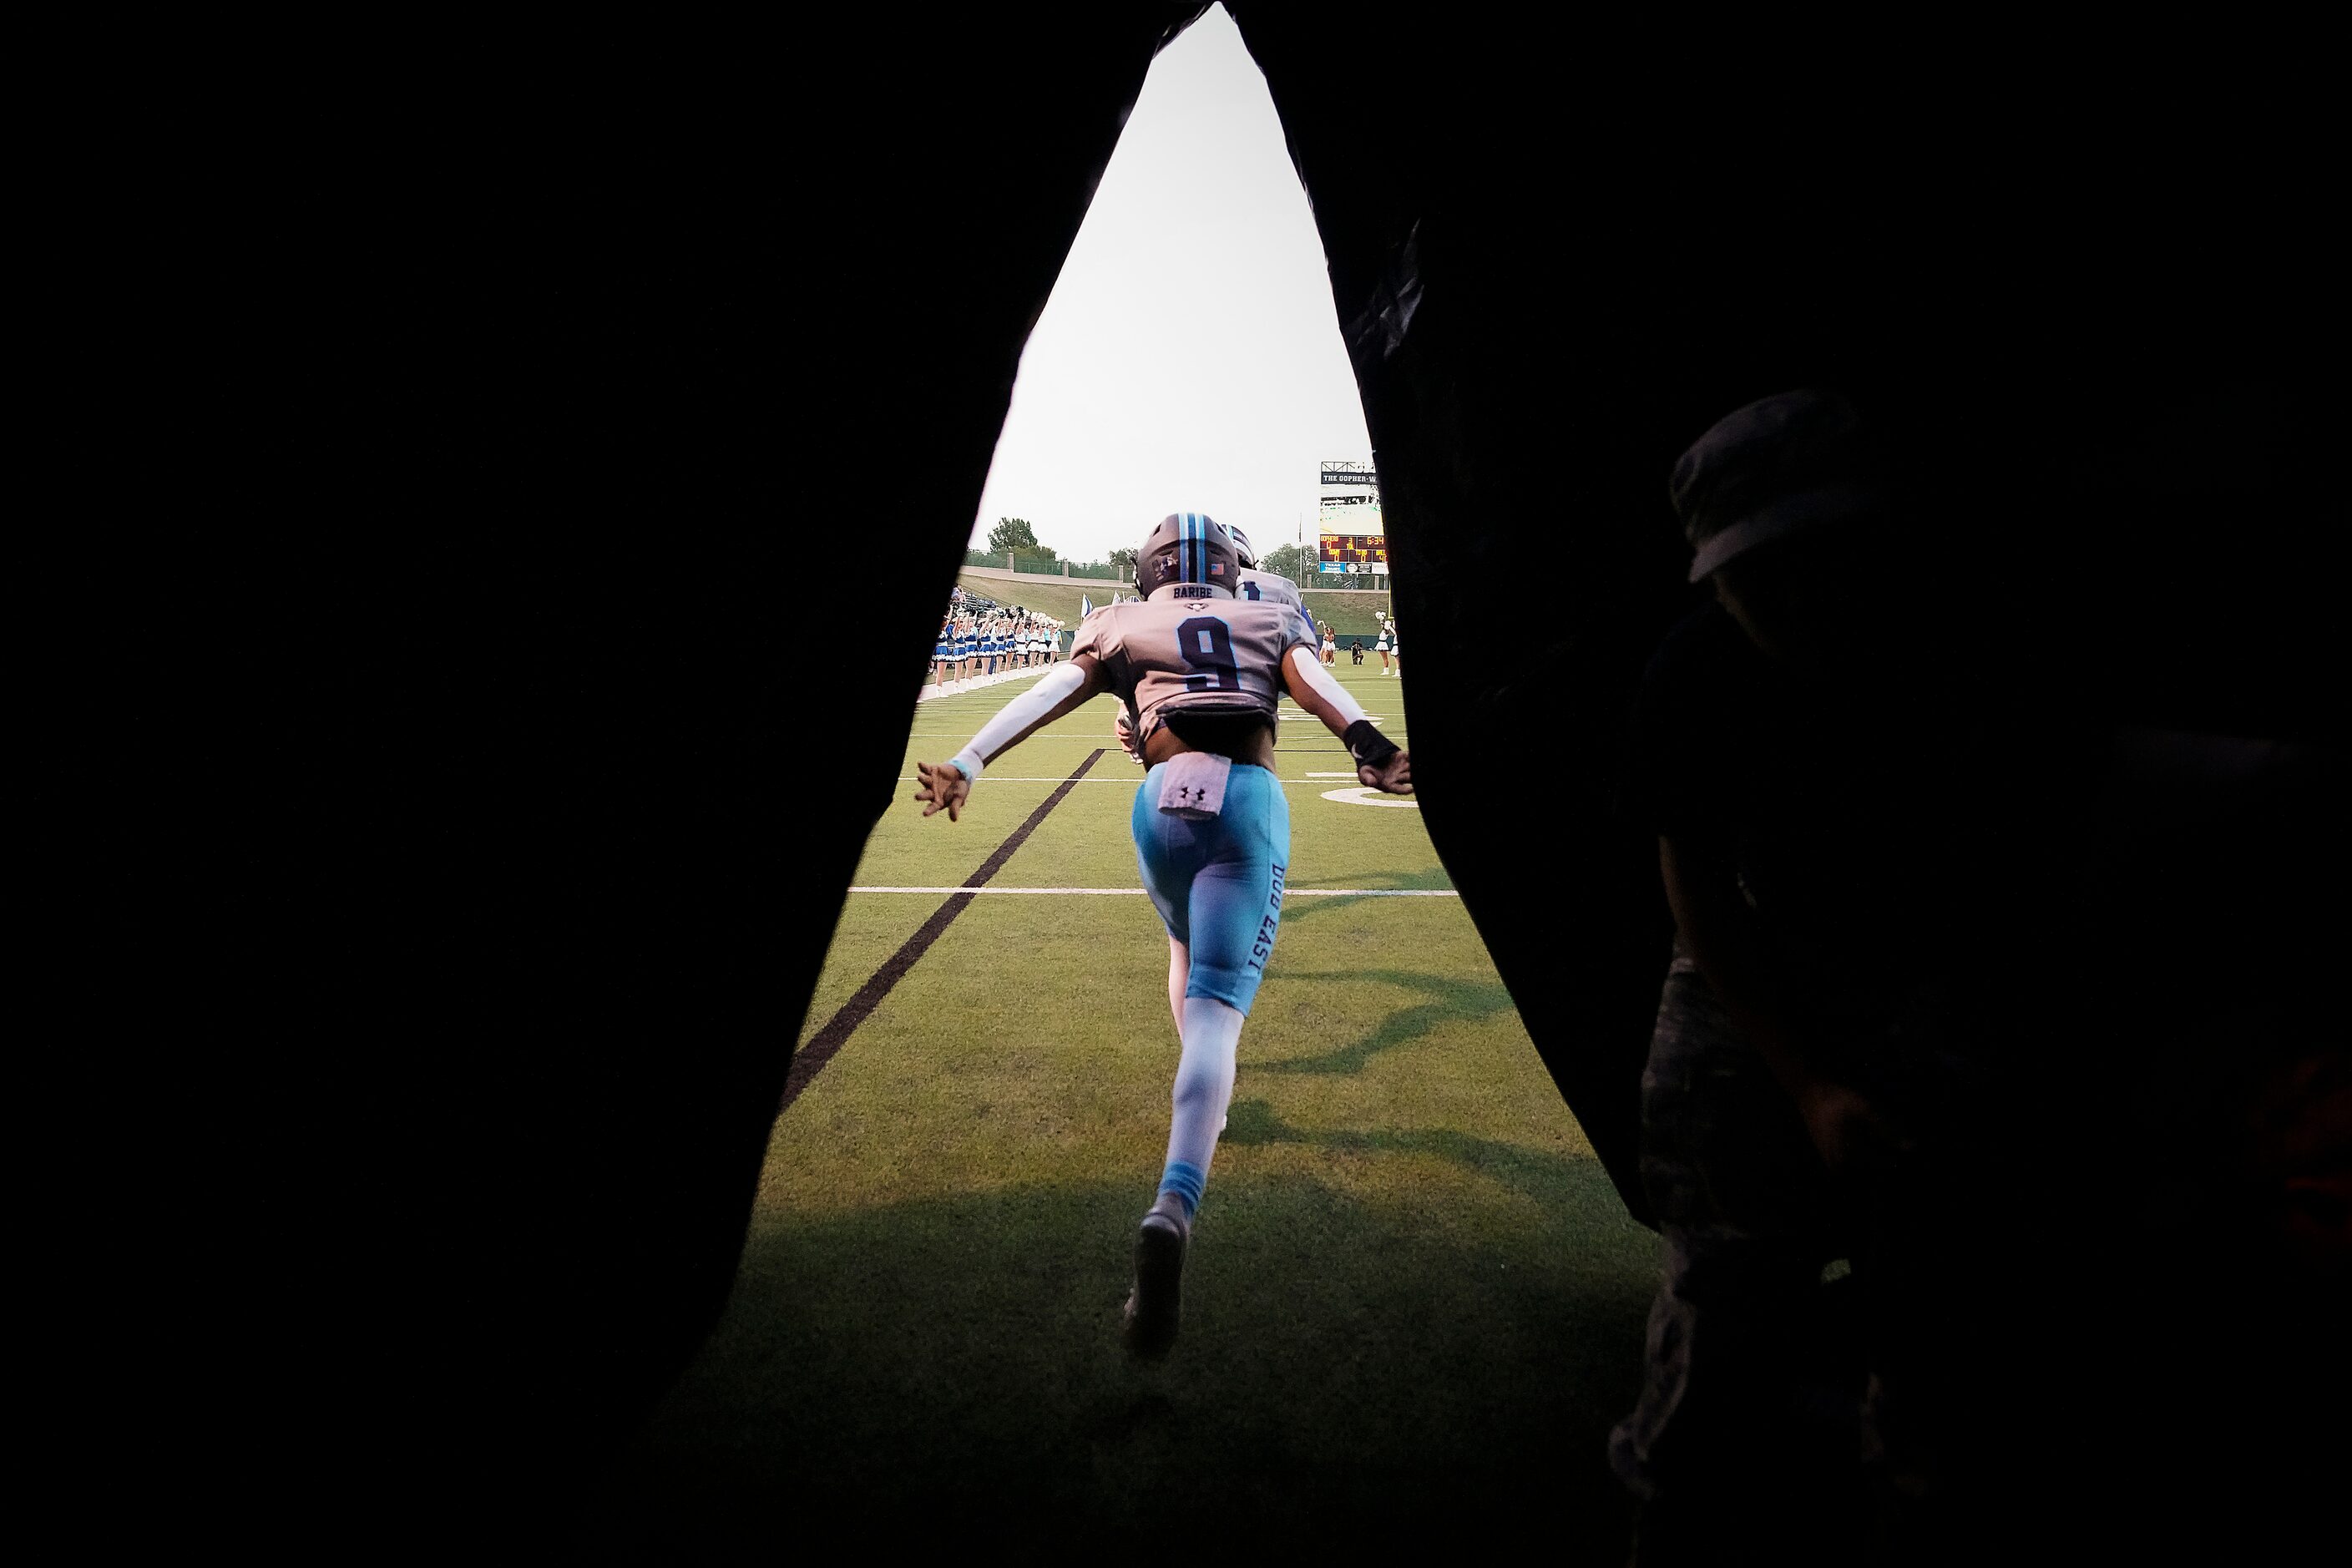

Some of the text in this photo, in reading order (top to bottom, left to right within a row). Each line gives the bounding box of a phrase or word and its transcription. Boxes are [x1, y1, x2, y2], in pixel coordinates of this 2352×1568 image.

[1367, 536, 1383, 544] 6:34
[1174, 587, 1212, 599] BARIBE
[1176, 616, 1242, 692] 9
